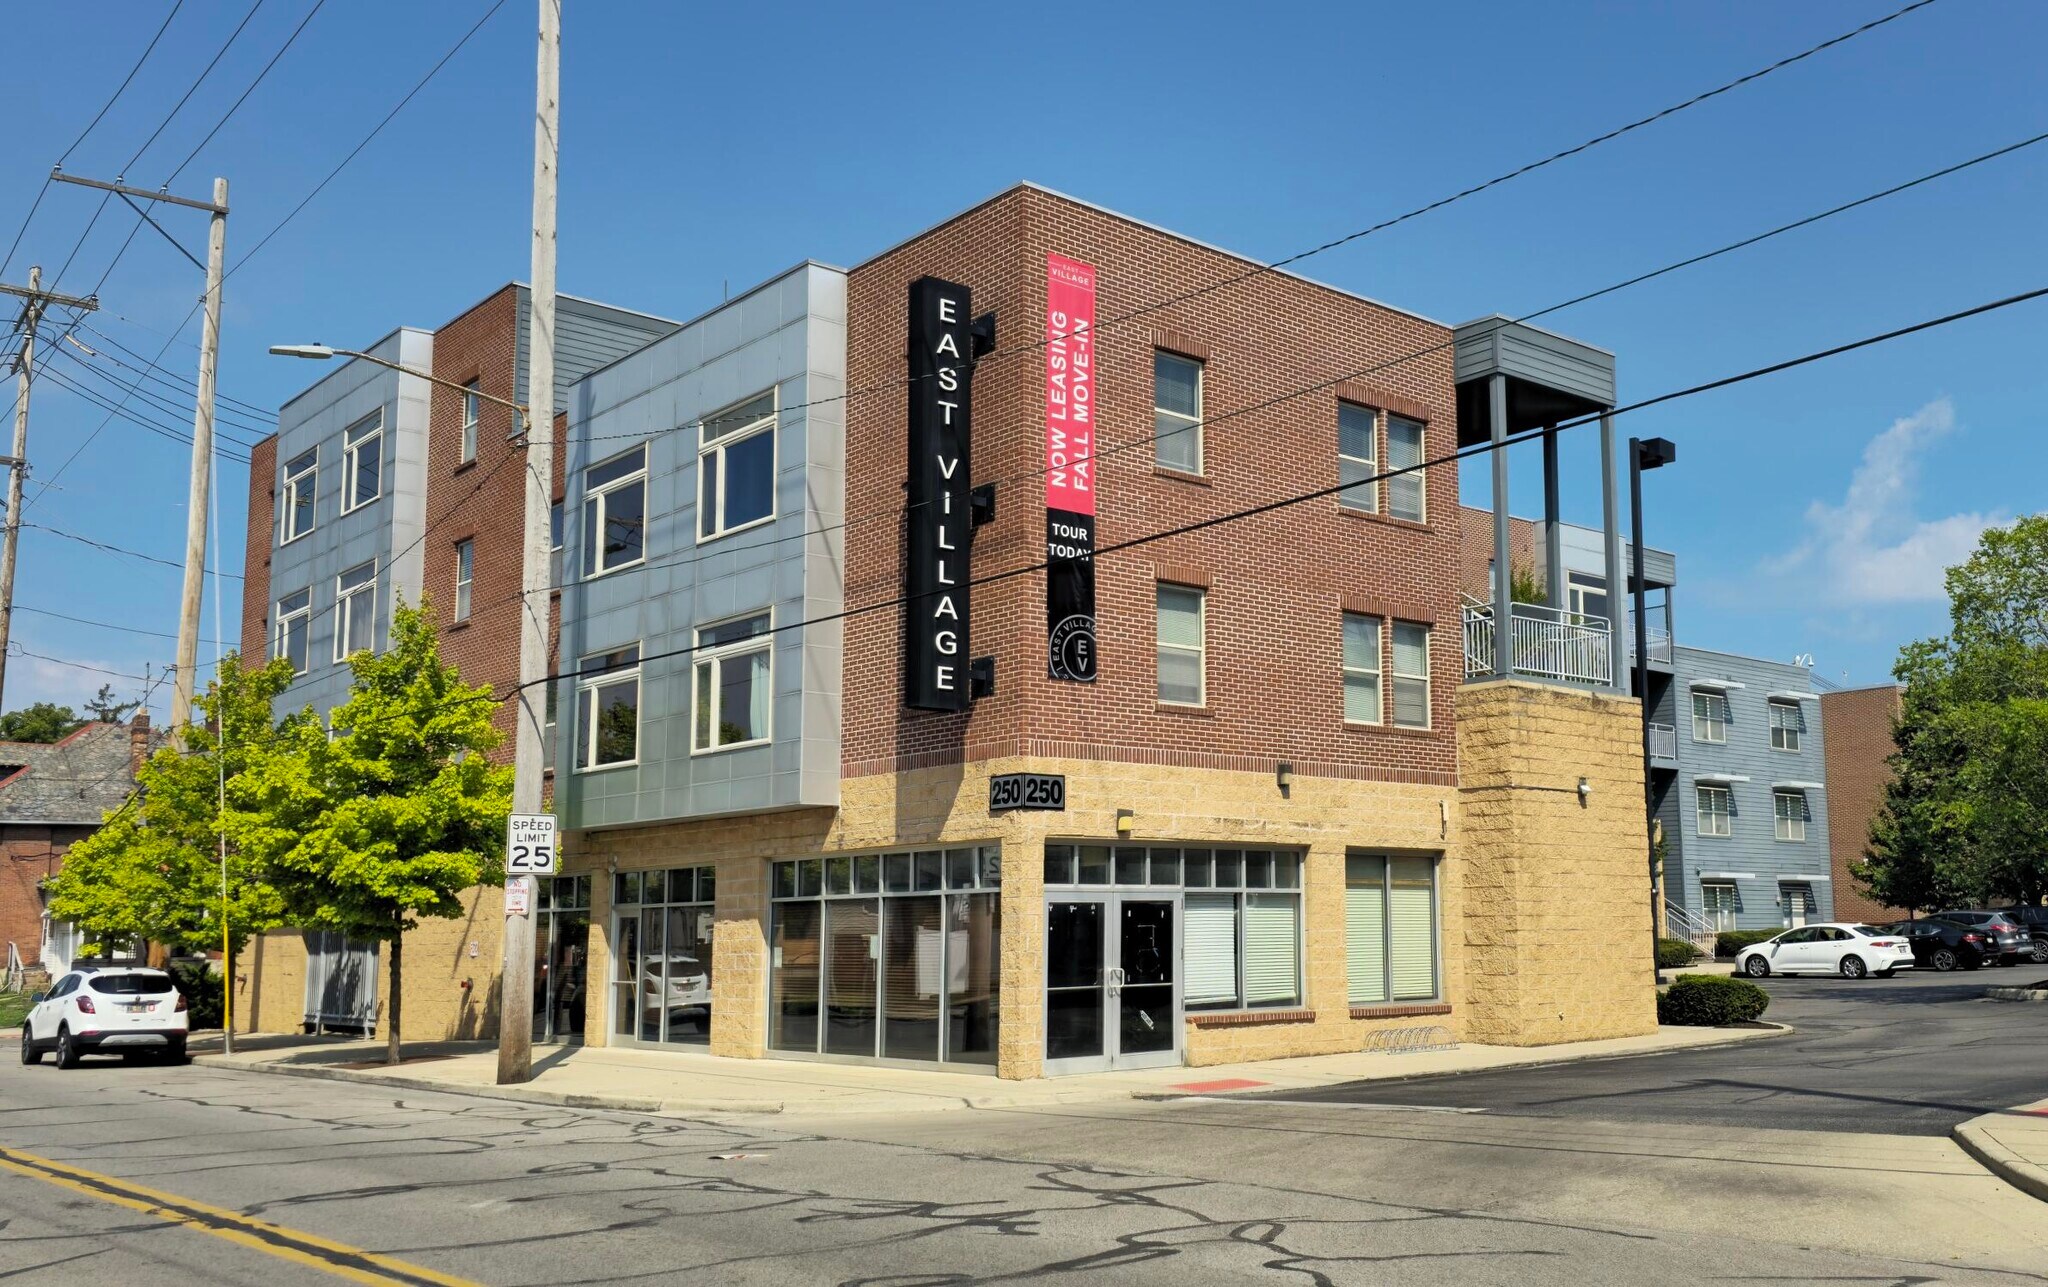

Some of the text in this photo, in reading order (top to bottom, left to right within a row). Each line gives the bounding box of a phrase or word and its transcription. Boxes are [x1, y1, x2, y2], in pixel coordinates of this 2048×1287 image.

[1052, 268, 1089, 286] VILLAGE
[1051, 311, 1068, 487] NOW LEASING
[1073, 318, 1089, 491] FALL MOVE-IN
[935, 297, 959, 691] EAST VILLAGE
[1052, 523, 1088, 541] TOUR
[1053, 630, 1064, 661] EAST
[992, 778, 1021, 805] 250
[1026, 778, 1062, 805] 250
[513, 820, 552, 831] SPEED
[516, 833, 547, 843] LIMIT
[512, 845, 551, 867] 25
